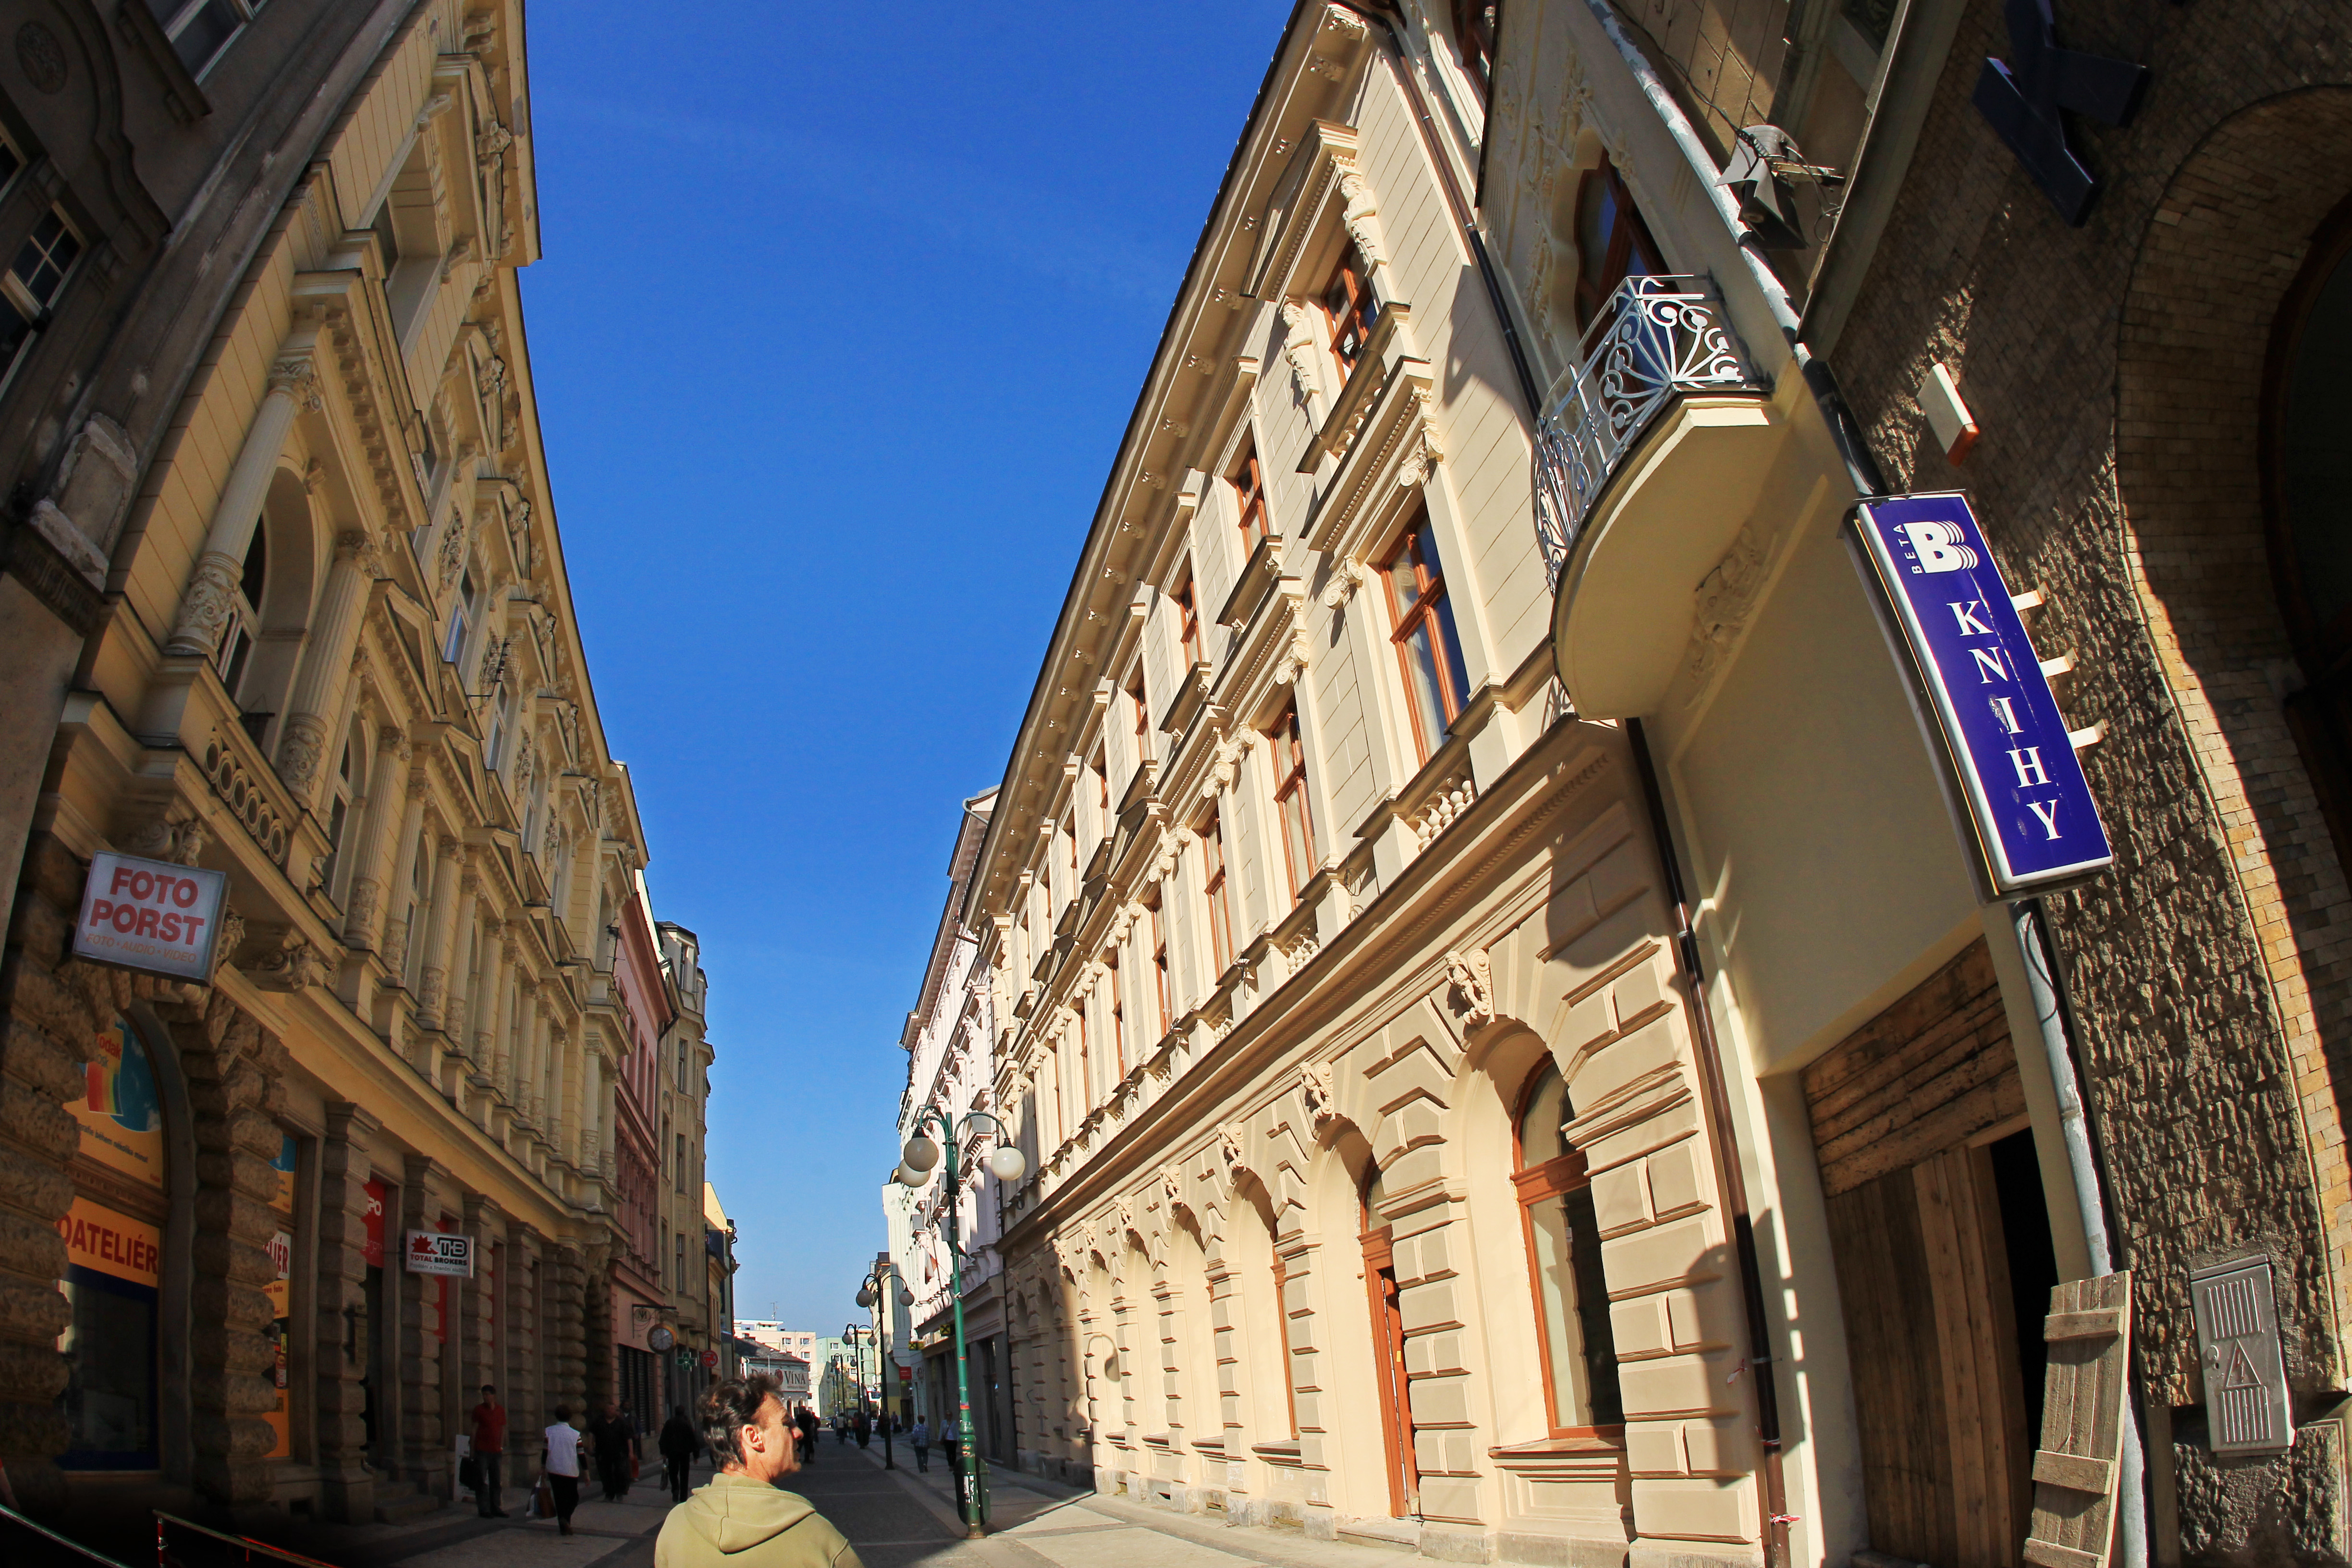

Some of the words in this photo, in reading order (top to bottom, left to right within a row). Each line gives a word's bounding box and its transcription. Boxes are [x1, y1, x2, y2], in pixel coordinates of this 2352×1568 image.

[1893, 524, 1923, 575] BETA
[1947, 600, 2062, 841] KNIHY
[110, 866, 198, 908] FOTO
[89, 898, 205, 945] PORST
[86, 933, 115, 947] FOTO
[121, 941, 156, 956] AUDIO
[163, 948, 196, 963] VIDEO
[56, 1213, 158, 1275] OATELIÉR
[410, 1253, 433, 1262] TOTAL
[434, 1257, 467, 1266] BROKERS
[784, 1371, 806, 1384] VÍNA
